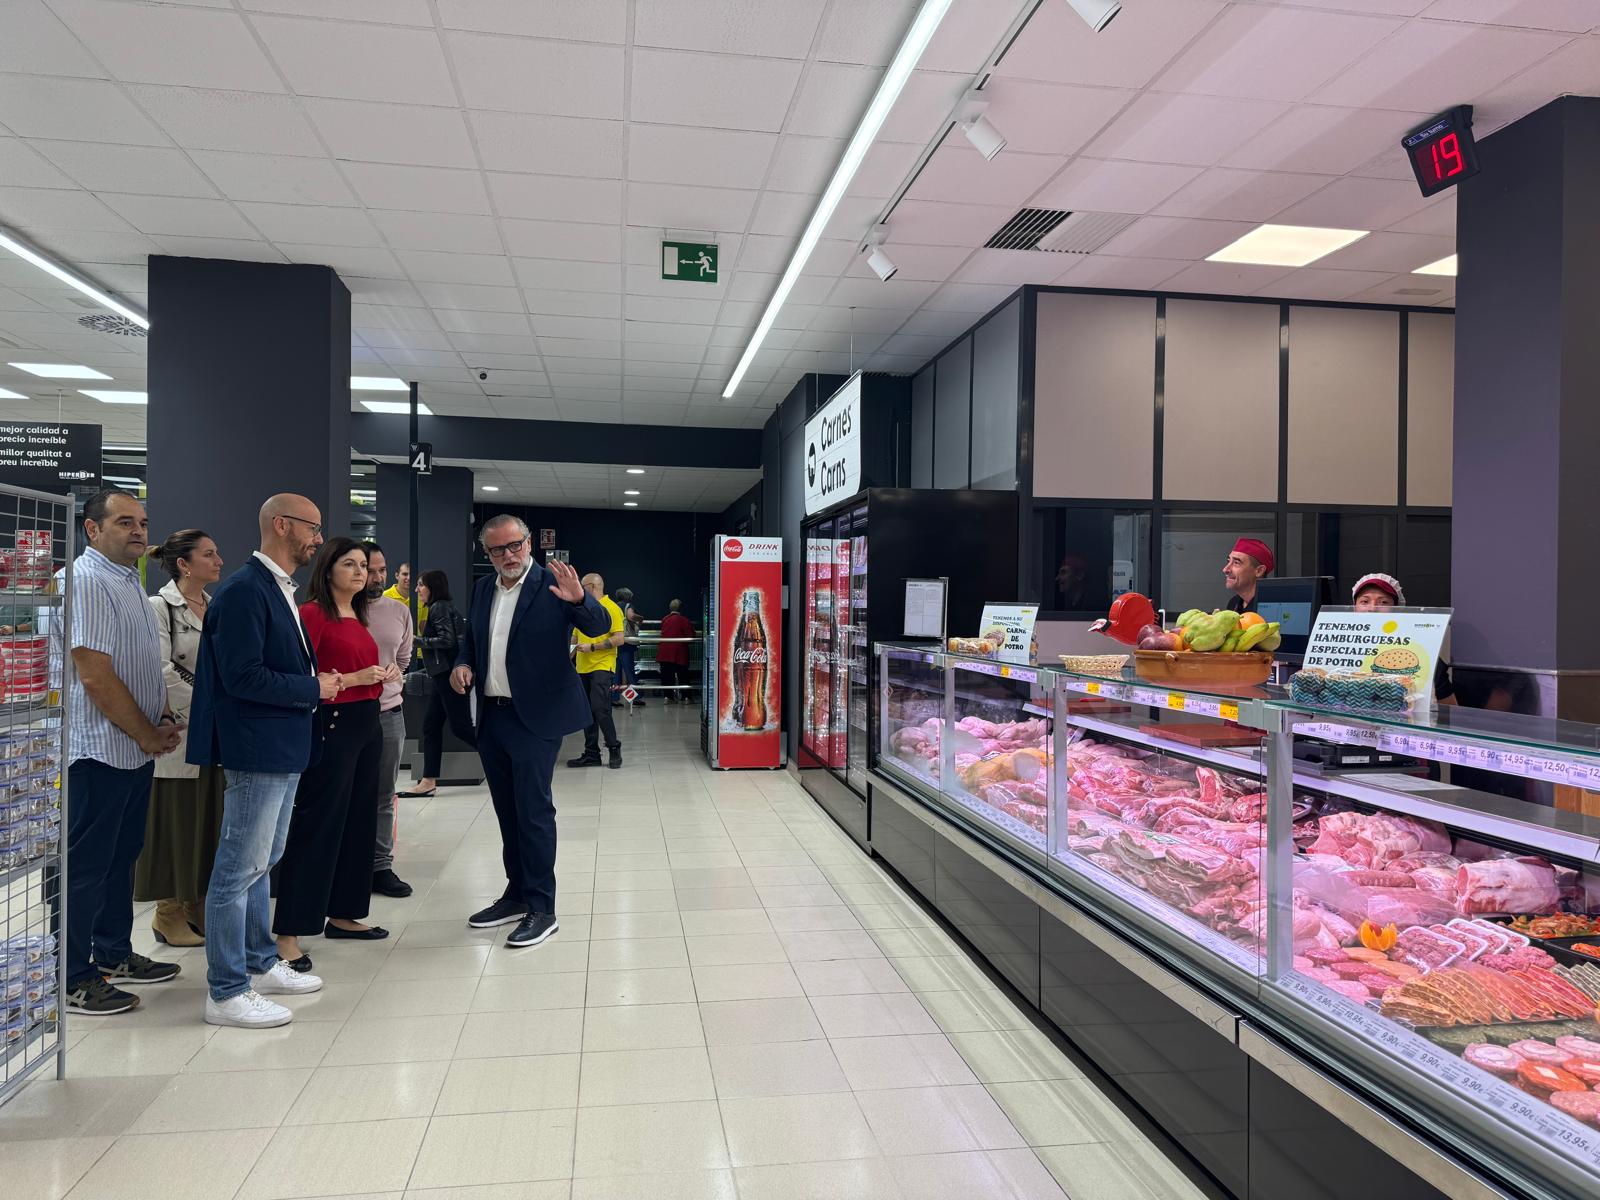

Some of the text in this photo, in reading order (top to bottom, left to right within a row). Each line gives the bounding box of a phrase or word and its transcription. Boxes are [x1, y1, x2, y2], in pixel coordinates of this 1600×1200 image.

[1432, 132, 1462, 179] 19
[26, 426, 59, 434] calidad
[821, 405, 852, 452] Carnes
[26, 450, 62, 458] qualitat
[412, 452, 426, 470] 4
[821, 458, 846, 496] Carns
[1318, 622, 1371, 632] TENEMOS
[1314, 634, 1410, 646] HAMBURGUESAS
[1311, 645, 1379, 656] ESPECIALES
[1308, 656, 1363, 667] DE POTRO
[1558, 1129, 1590, 1152] 13,95€
